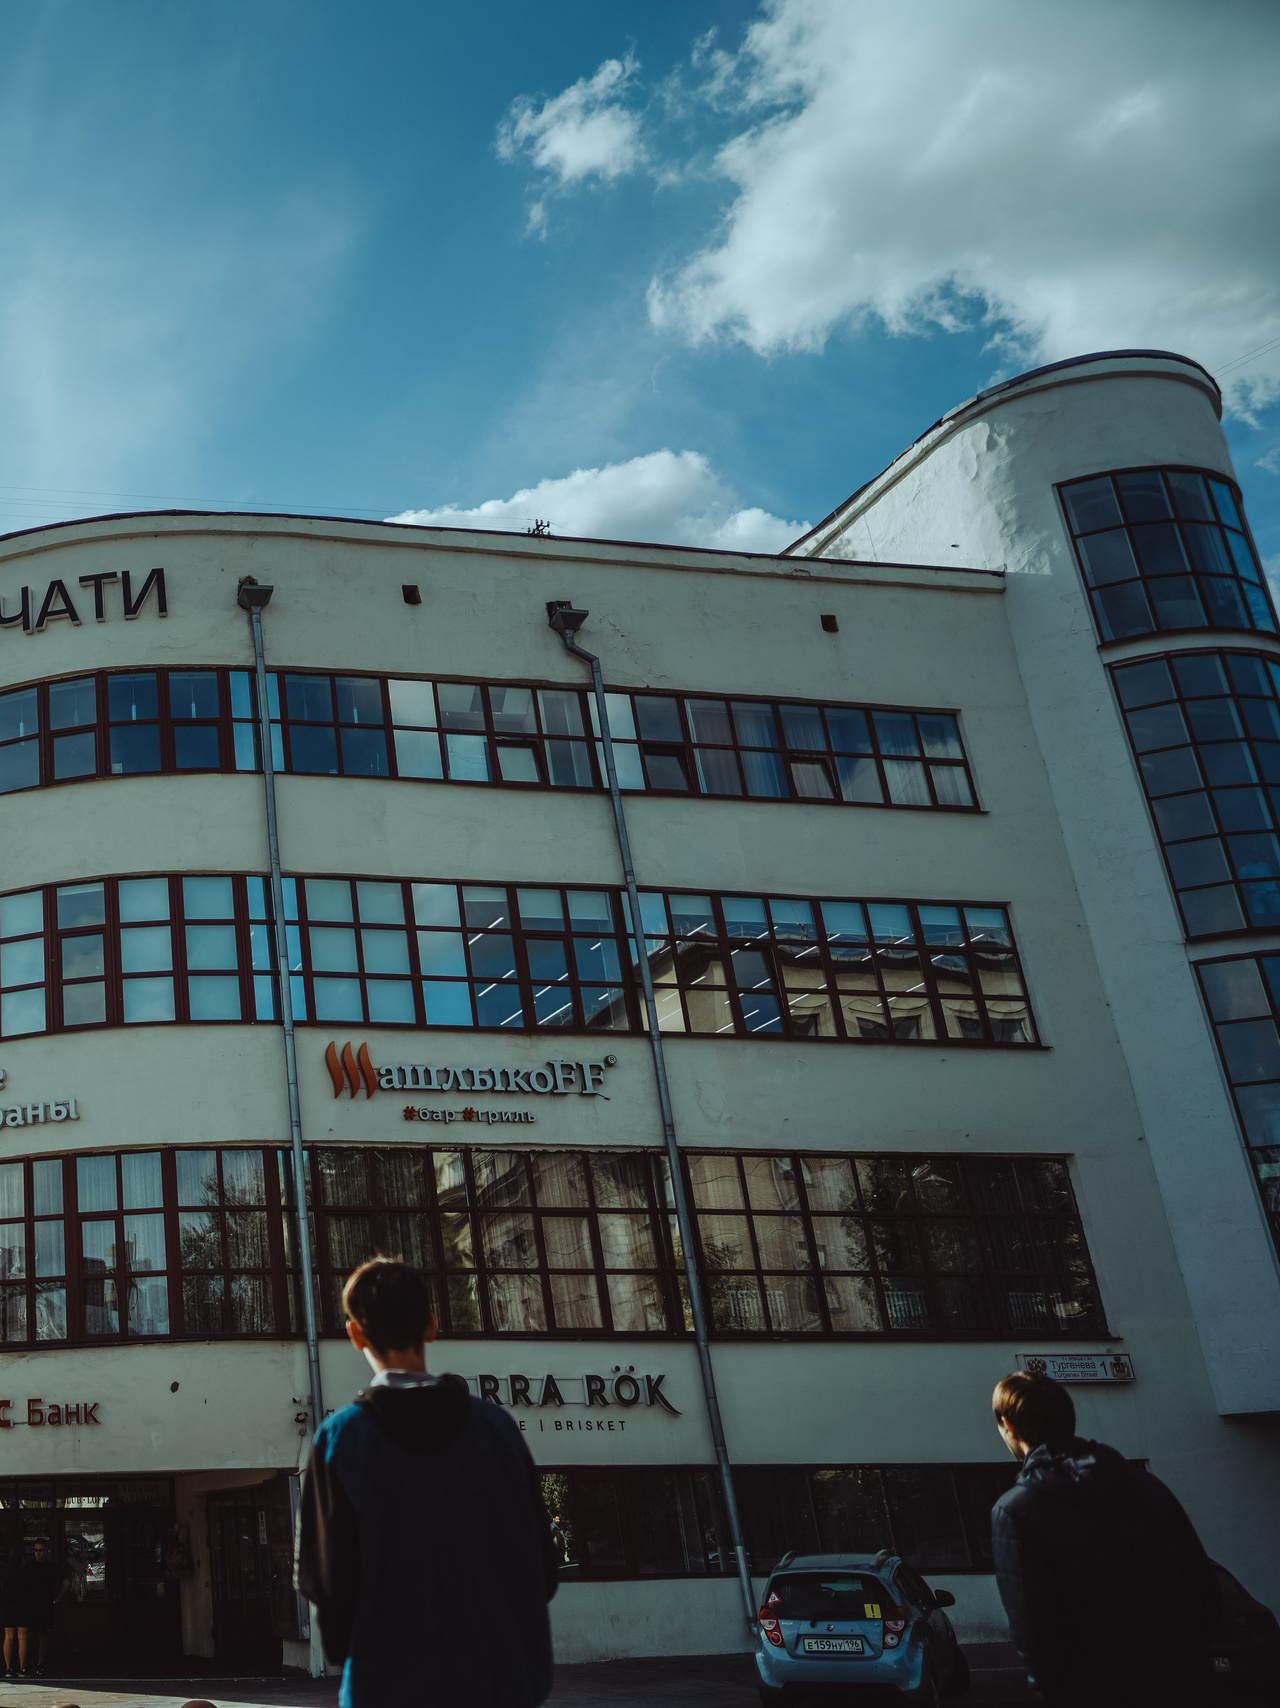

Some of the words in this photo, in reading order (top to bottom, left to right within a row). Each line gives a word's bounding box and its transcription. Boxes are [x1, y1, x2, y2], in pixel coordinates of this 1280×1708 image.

[1049, 1360, 1097, 1372] Тургенева
[1099, 1360, 1108, 1377] 1
[477, 1374, 566, 1406] RRA
[583, 1365, 683, 1416] RÖK
[27, 1398, 101, 1427] Банк
[554, 1420, 627, 1431] BRISKET
